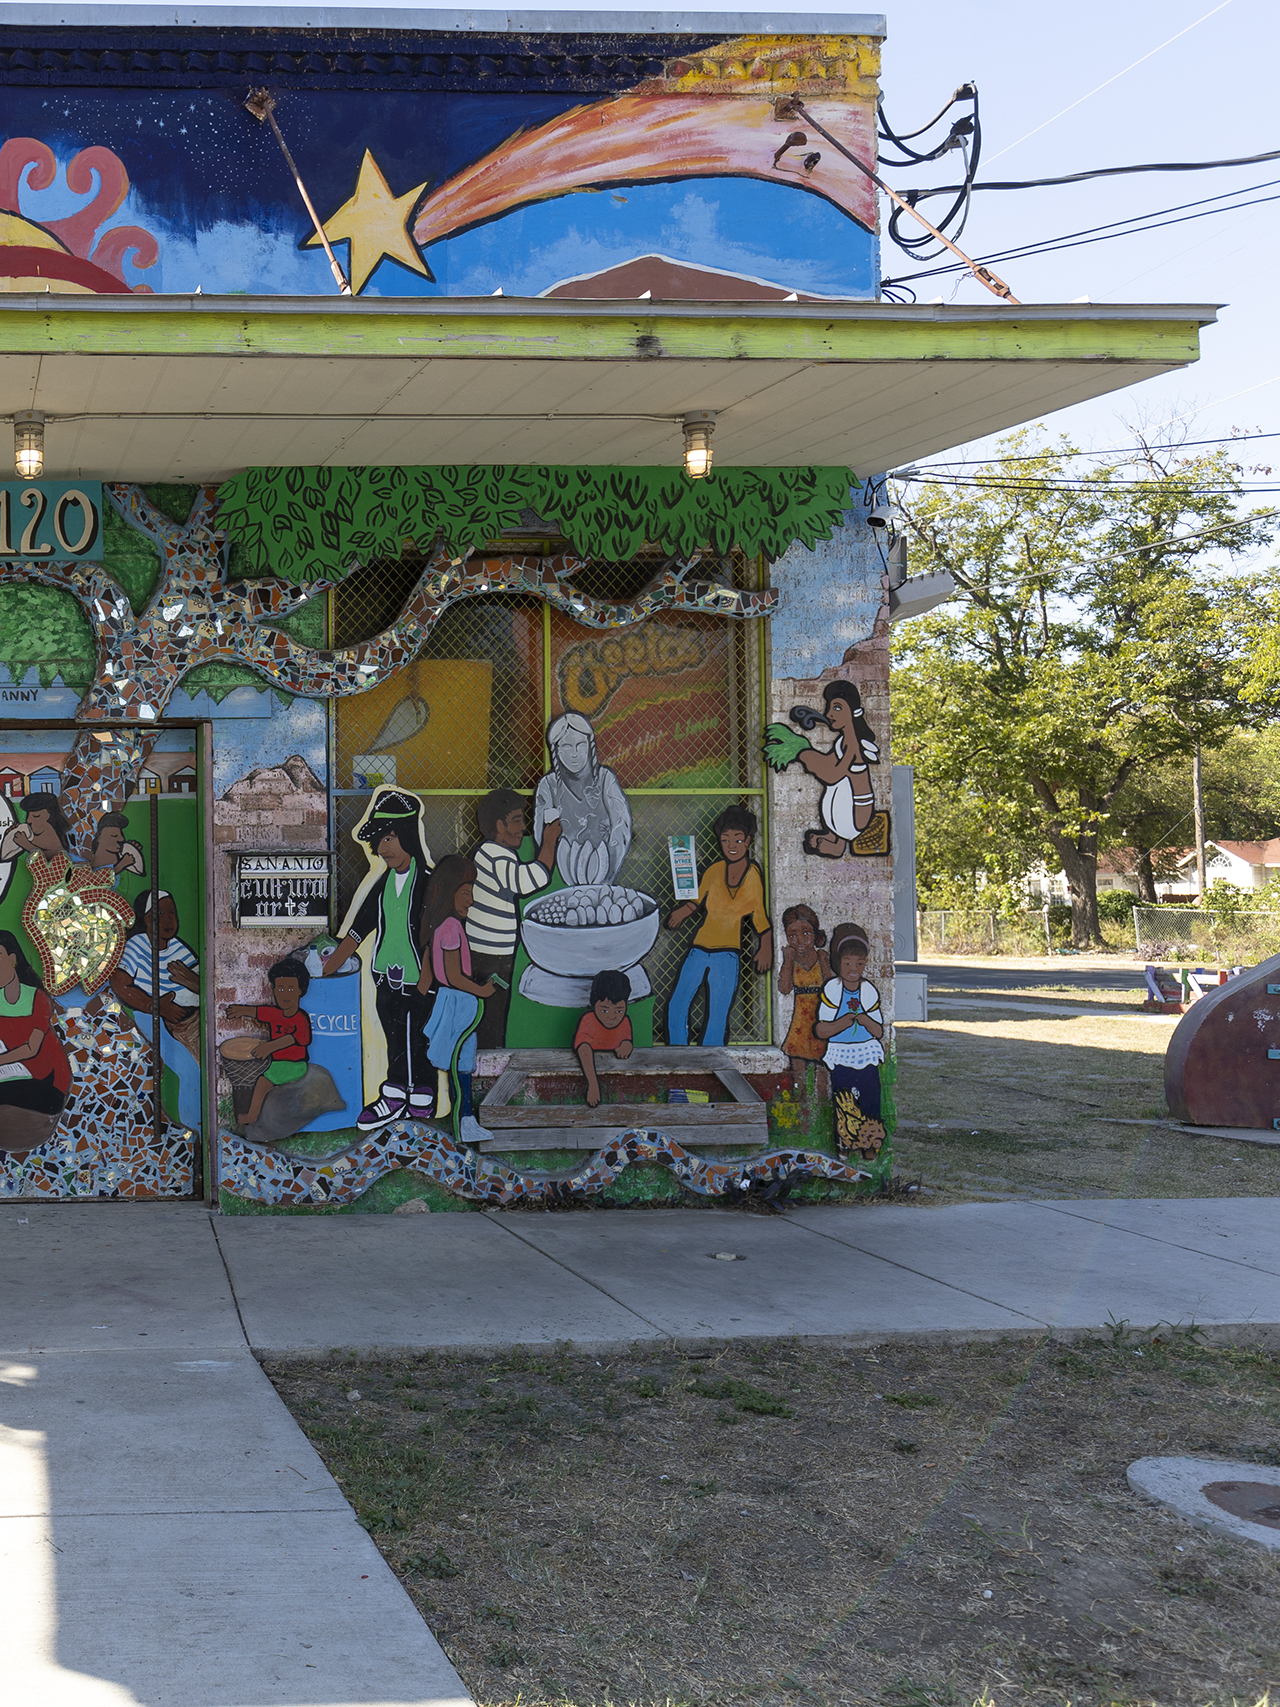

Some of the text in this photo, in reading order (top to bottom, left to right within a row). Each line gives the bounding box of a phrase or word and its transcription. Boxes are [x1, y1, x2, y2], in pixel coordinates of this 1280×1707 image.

[281, 856, 324, 870] ANTO
[255, 896, 310, 917] arts
[308, 1013, 358, 1031] ECYCLE
